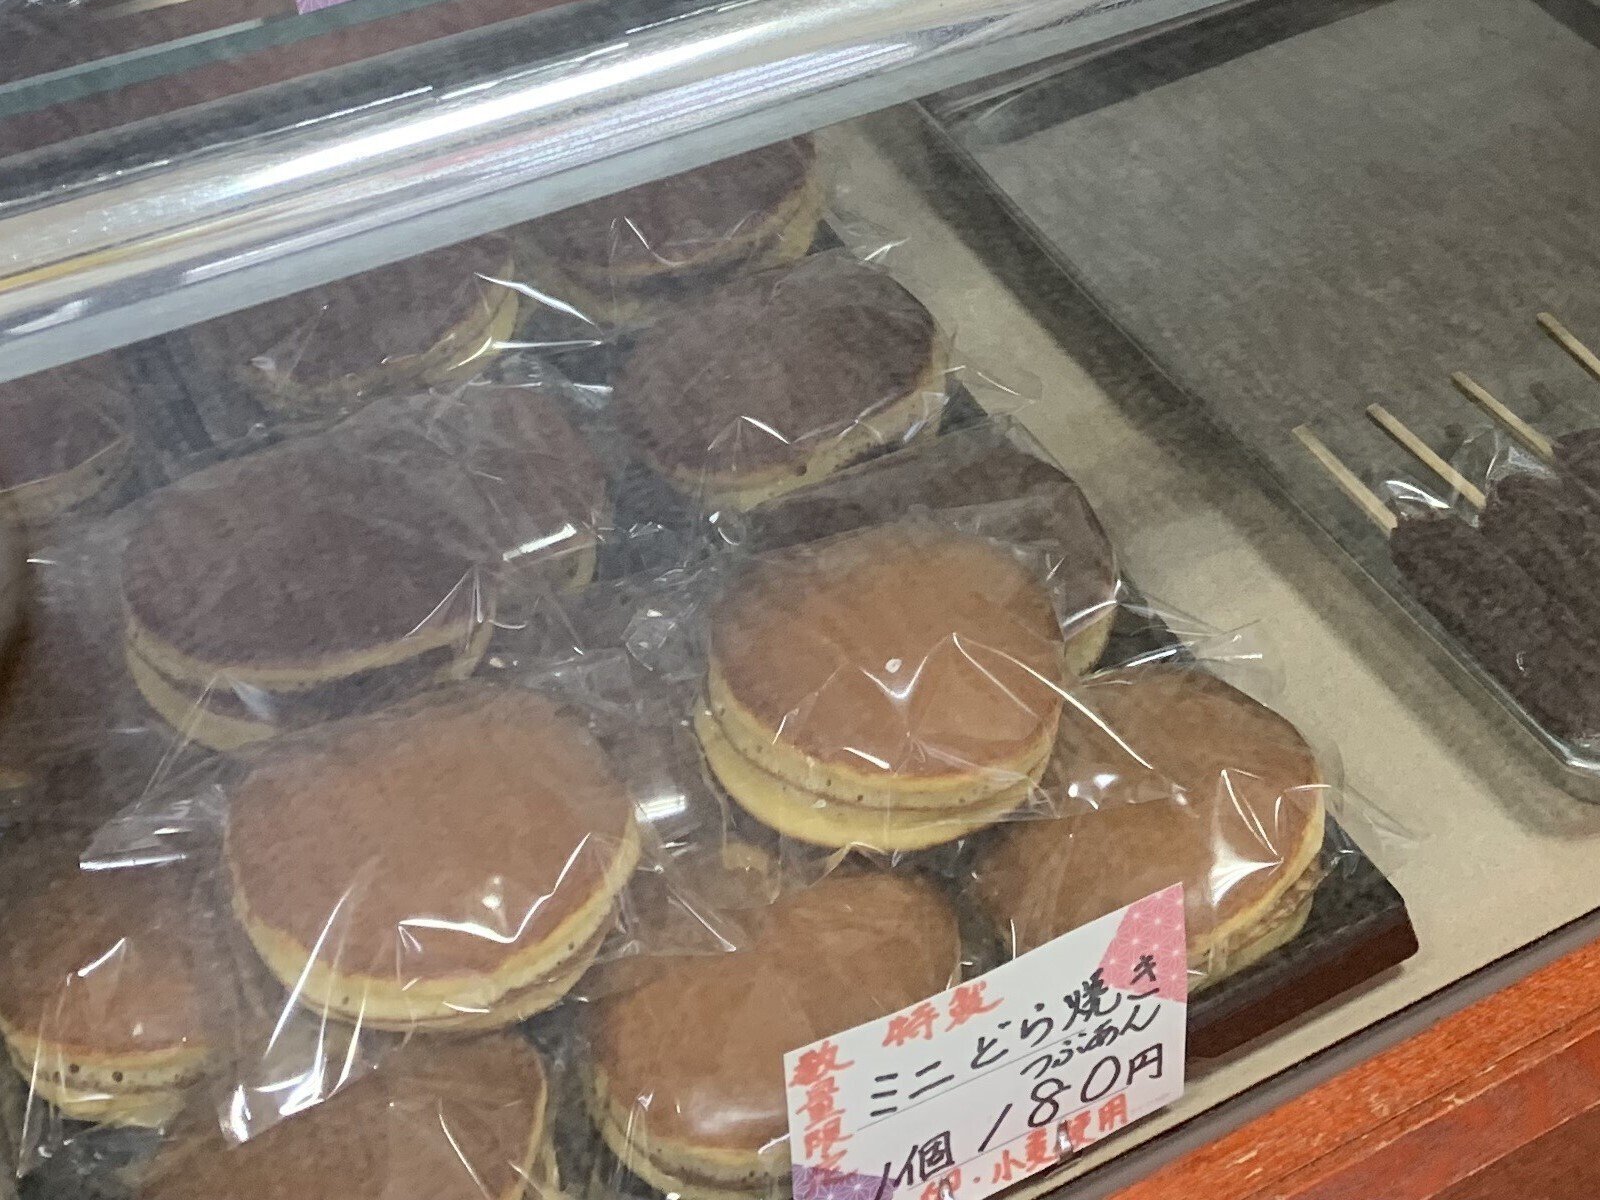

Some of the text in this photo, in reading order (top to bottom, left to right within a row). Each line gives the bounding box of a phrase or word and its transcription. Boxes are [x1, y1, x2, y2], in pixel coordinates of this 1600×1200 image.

[870, 953, 1161, 1118] ミニどら焼き
[881, 980, 1005, 1047] 特製
[1020, 1004, 1161, 1080] つぶあん
